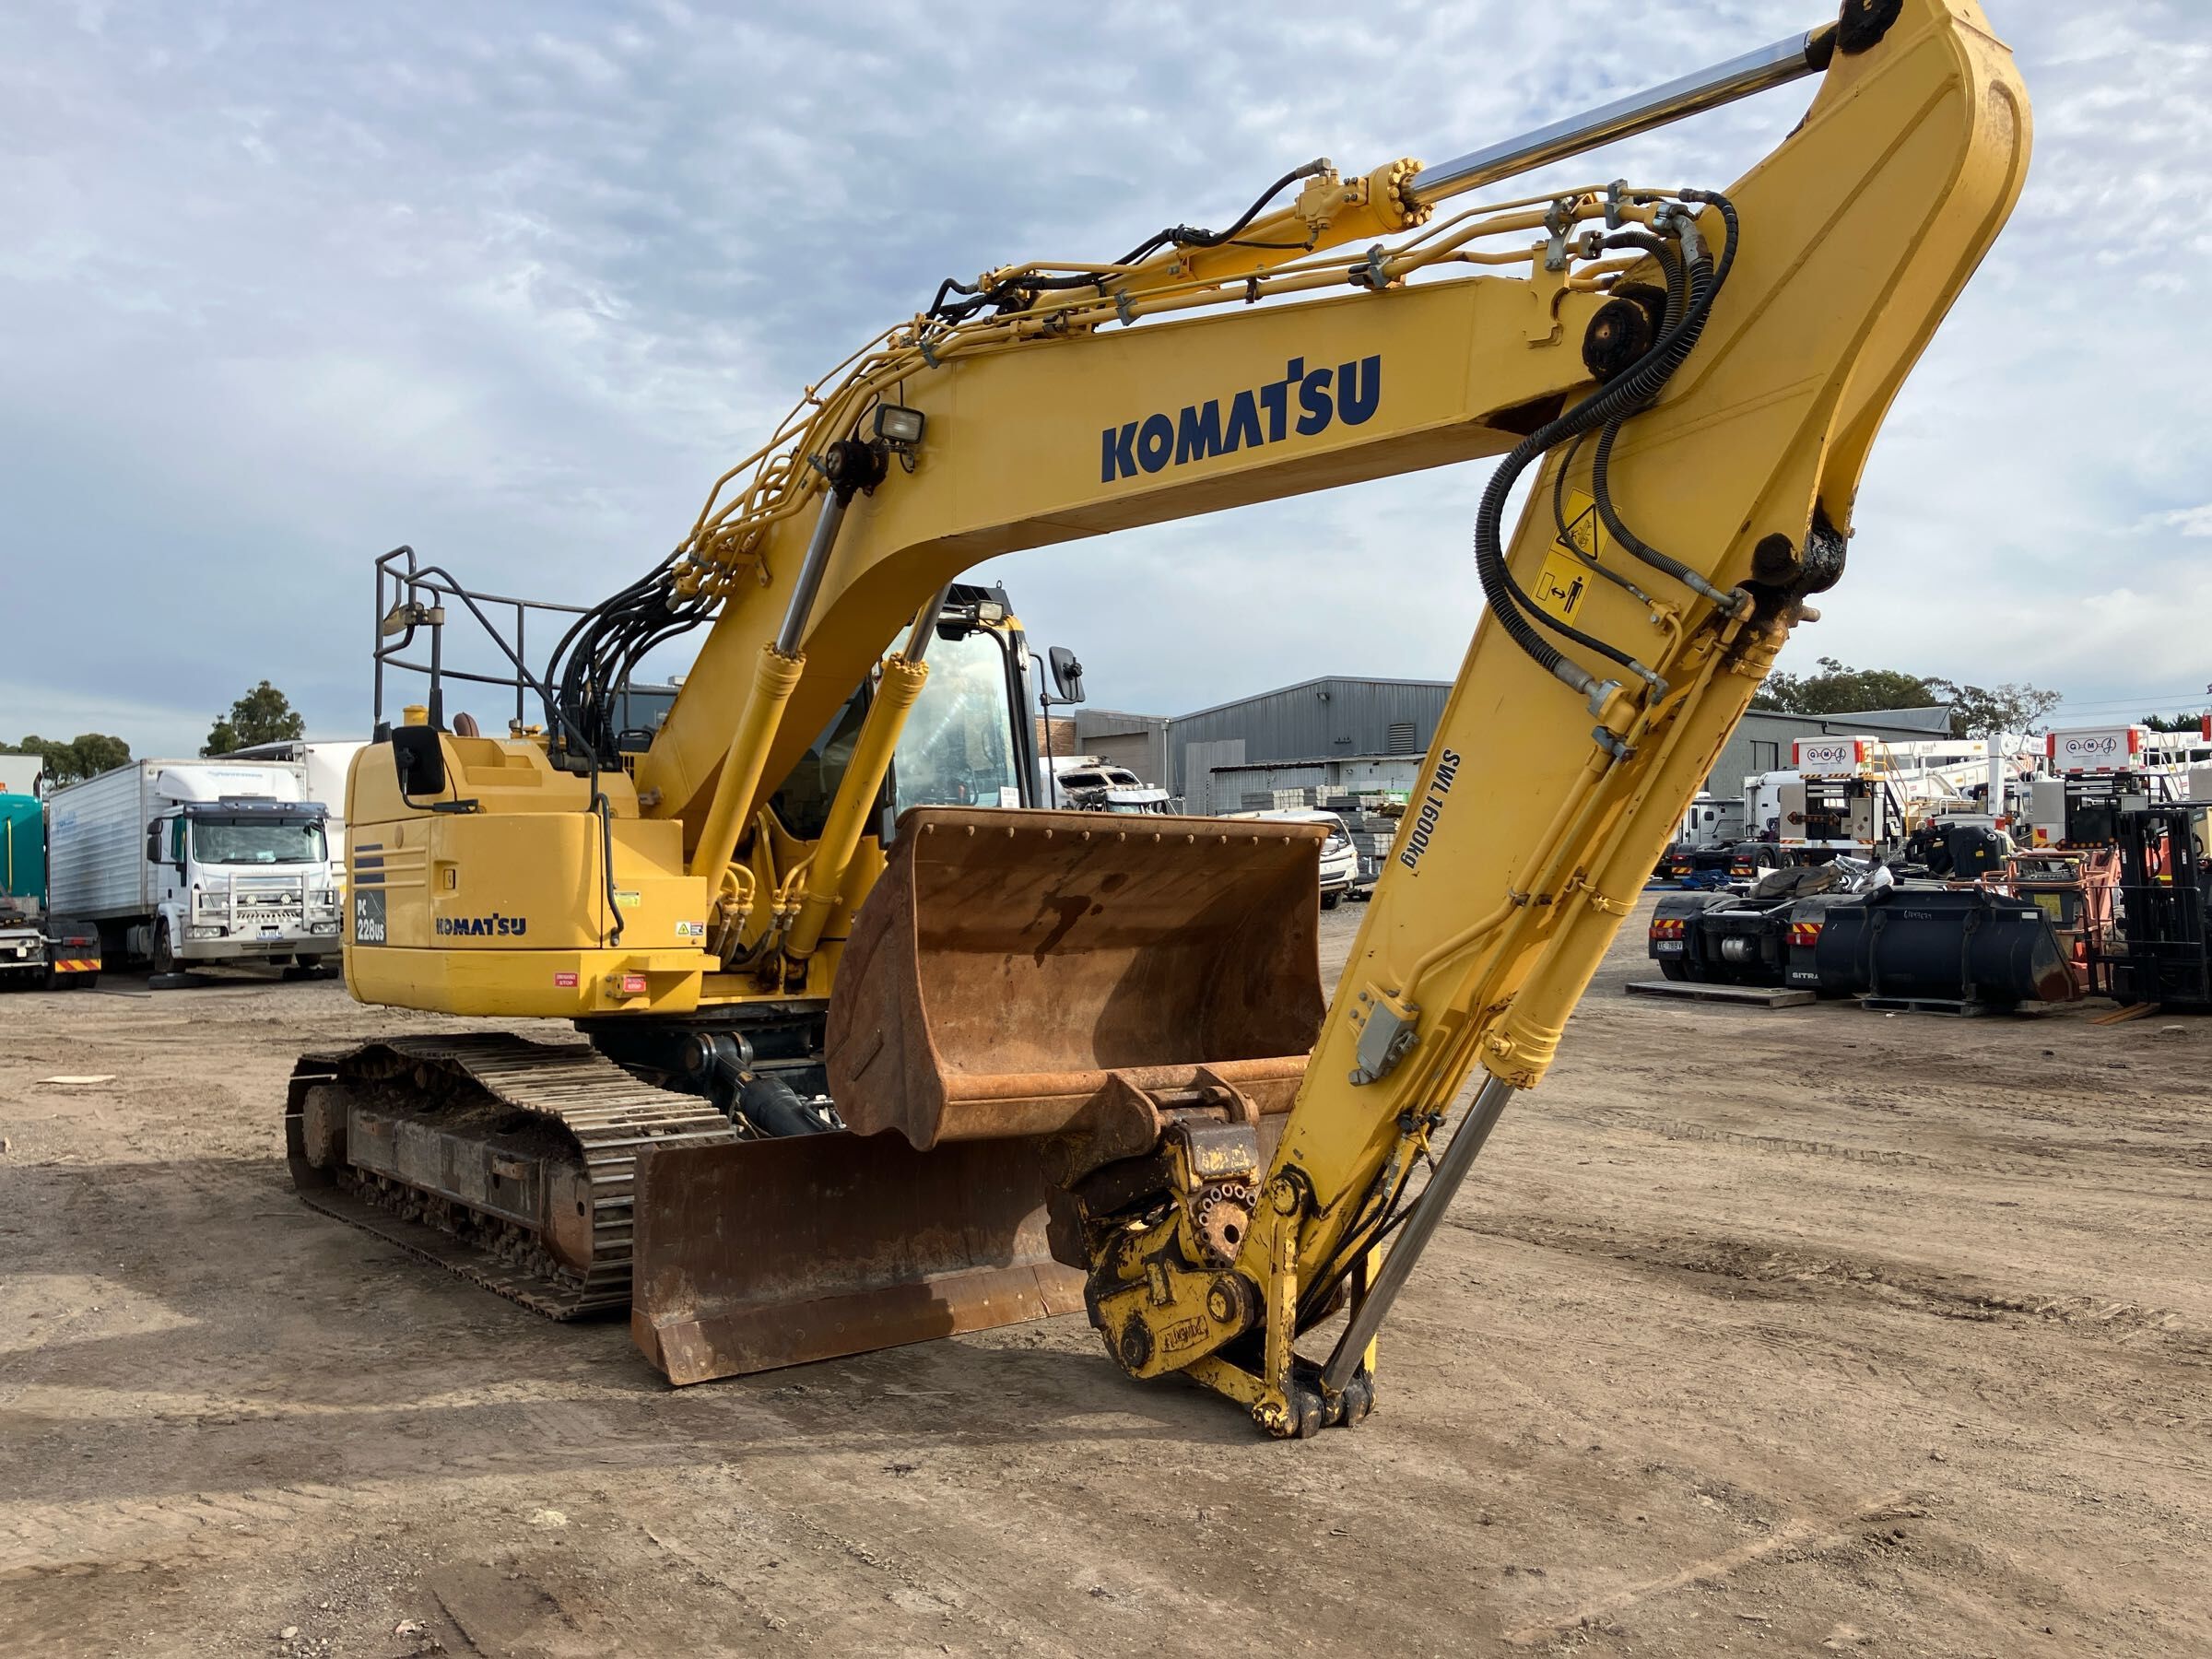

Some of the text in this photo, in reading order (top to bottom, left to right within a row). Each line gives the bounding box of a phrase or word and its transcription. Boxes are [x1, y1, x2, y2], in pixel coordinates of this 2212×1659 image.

[1101, 354, 1381, 484] KOMATSU
[1400, 748, 1461, 869] SWL 1600kg
[357, 899, 367, 916] PC
[357, 918, 384, 941] 228US
[436, 912, 526, 935] KOMATSU
